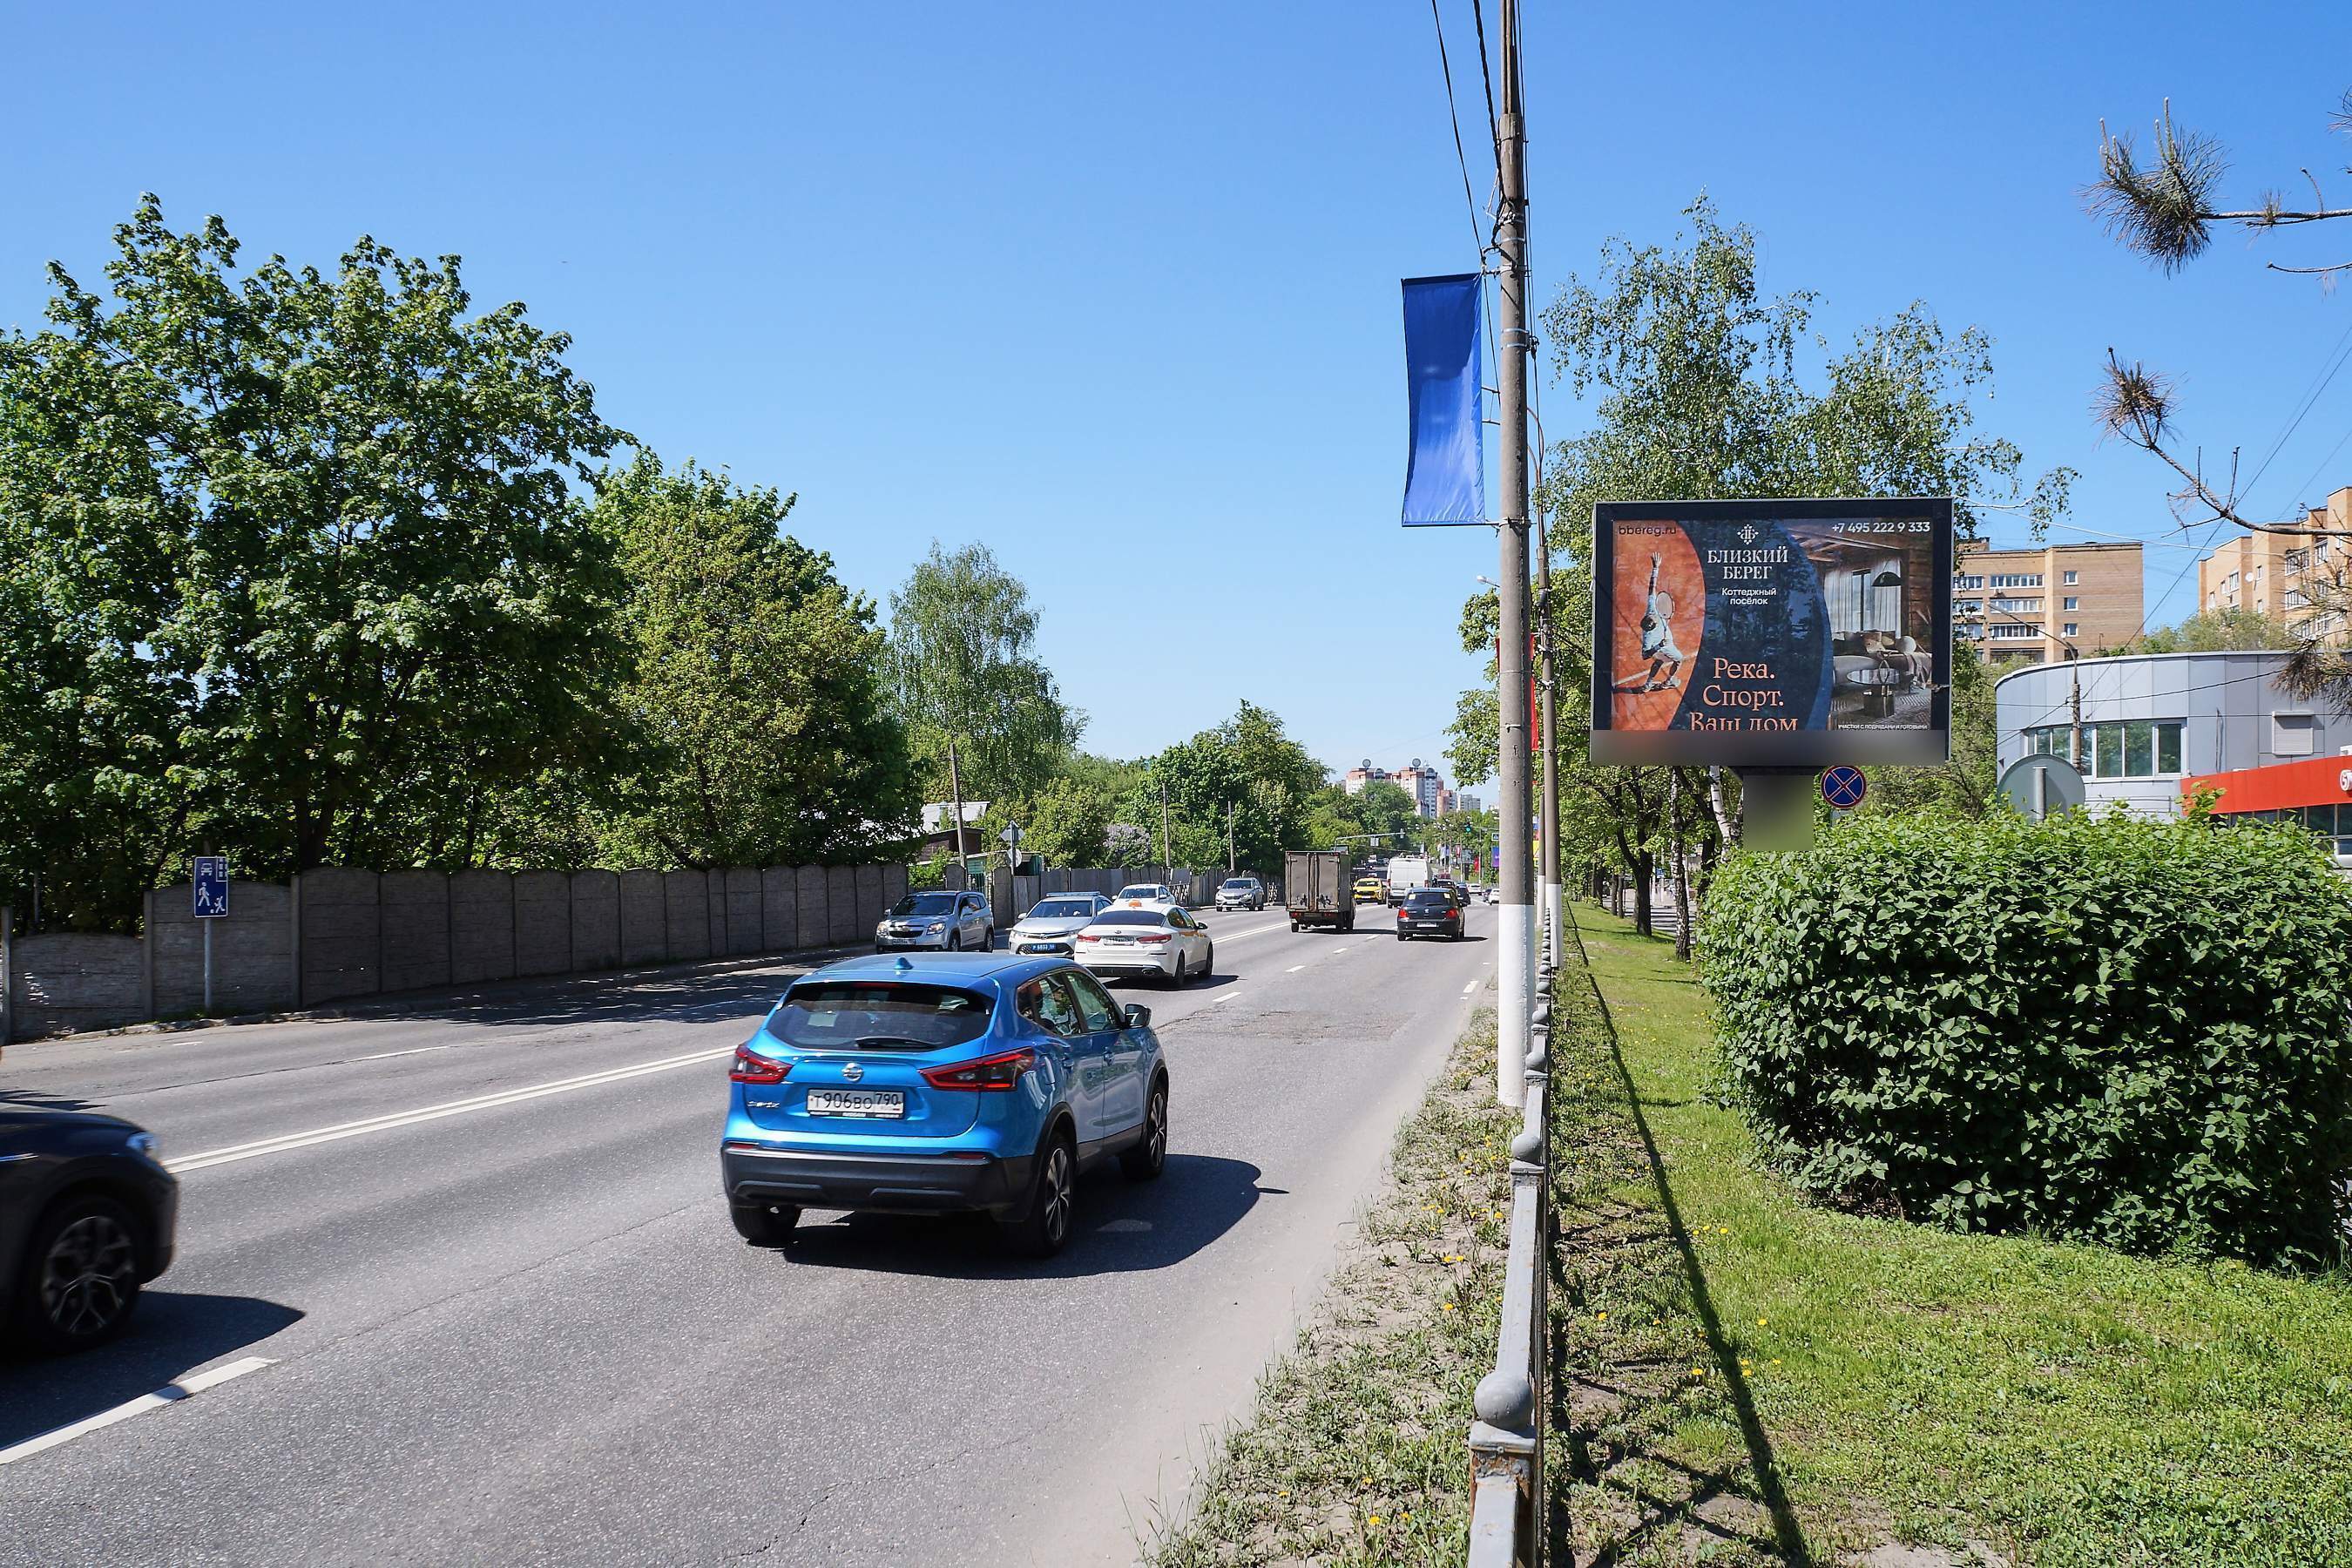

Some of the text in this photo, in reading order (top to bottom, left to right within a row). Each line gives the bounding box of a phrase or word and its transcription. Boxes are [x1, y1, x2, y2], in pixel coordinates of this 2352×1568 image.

[1619, 525, 1677, 537] bbereg.ru
[1832, 522, 1930, 533] +7 495 222 9 333
[1707, 545, 1788, 564] БЛИЗКИЙ
[1723, 566, 1772, 579] БЕРЕГ
[1721, 587, 1777, 598] Коттеджный
[1713, 658, 1775, 679] Река.
[1703, 685, 1784, 711] Спорт.
[1690, 712, 1740, 731] Ваш
[875, 1093, 899, 1105] 790
